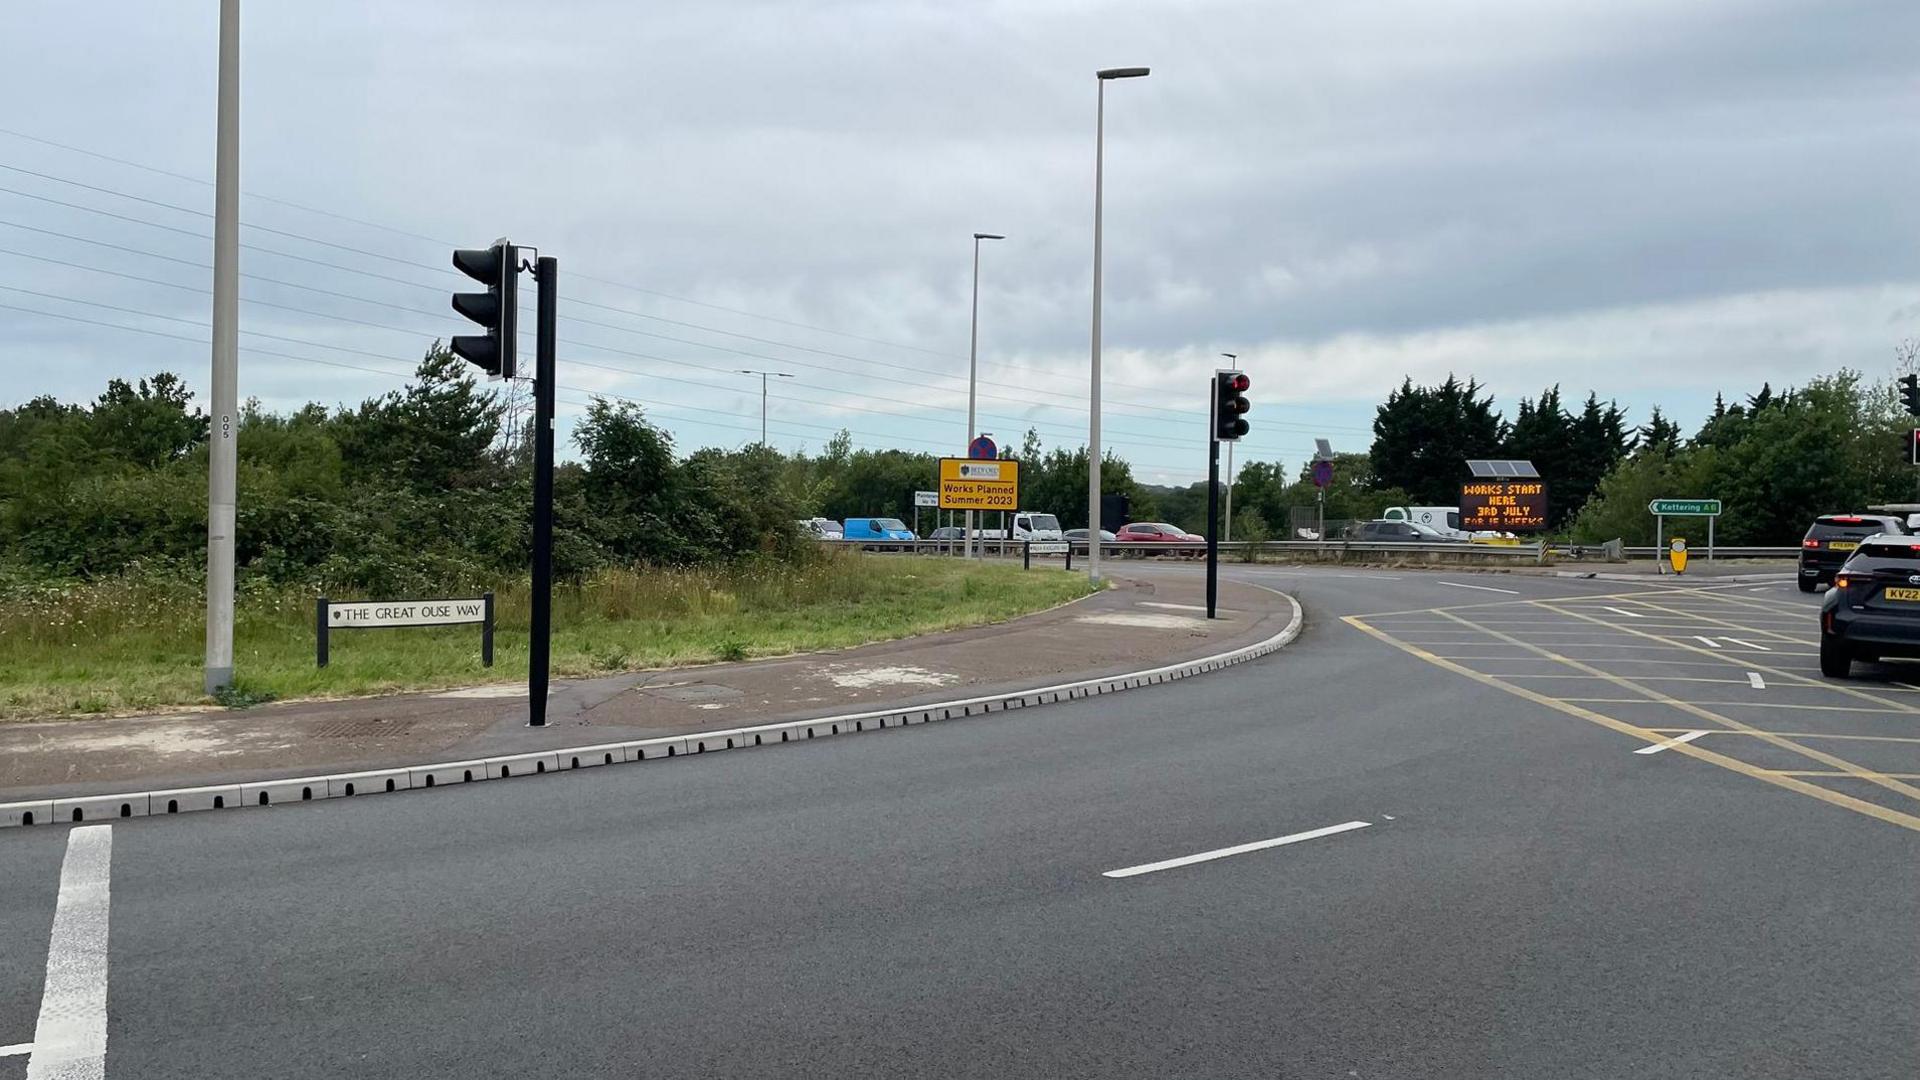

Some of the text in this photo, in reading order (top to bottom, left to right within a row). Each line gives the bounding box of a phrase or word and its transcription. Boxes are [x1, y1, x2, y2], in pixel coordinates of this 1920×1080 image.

[943, 484, 1015, 494] Works Planned
[1463, 484, 1542, 495] WORKS START
[945, 495, 984, 505] Summer
[987, 495, 1013, 505] 2023
[1488, 496, 1517, 505] HERE
[1477, 506, 1530, 517] 3RD JULY
[1661, 502, 1701, 512] Kettering
[1890, 589, 1919, 600] KV22
[344, 604, 481, 621] THE GREAT OUSE WAY
